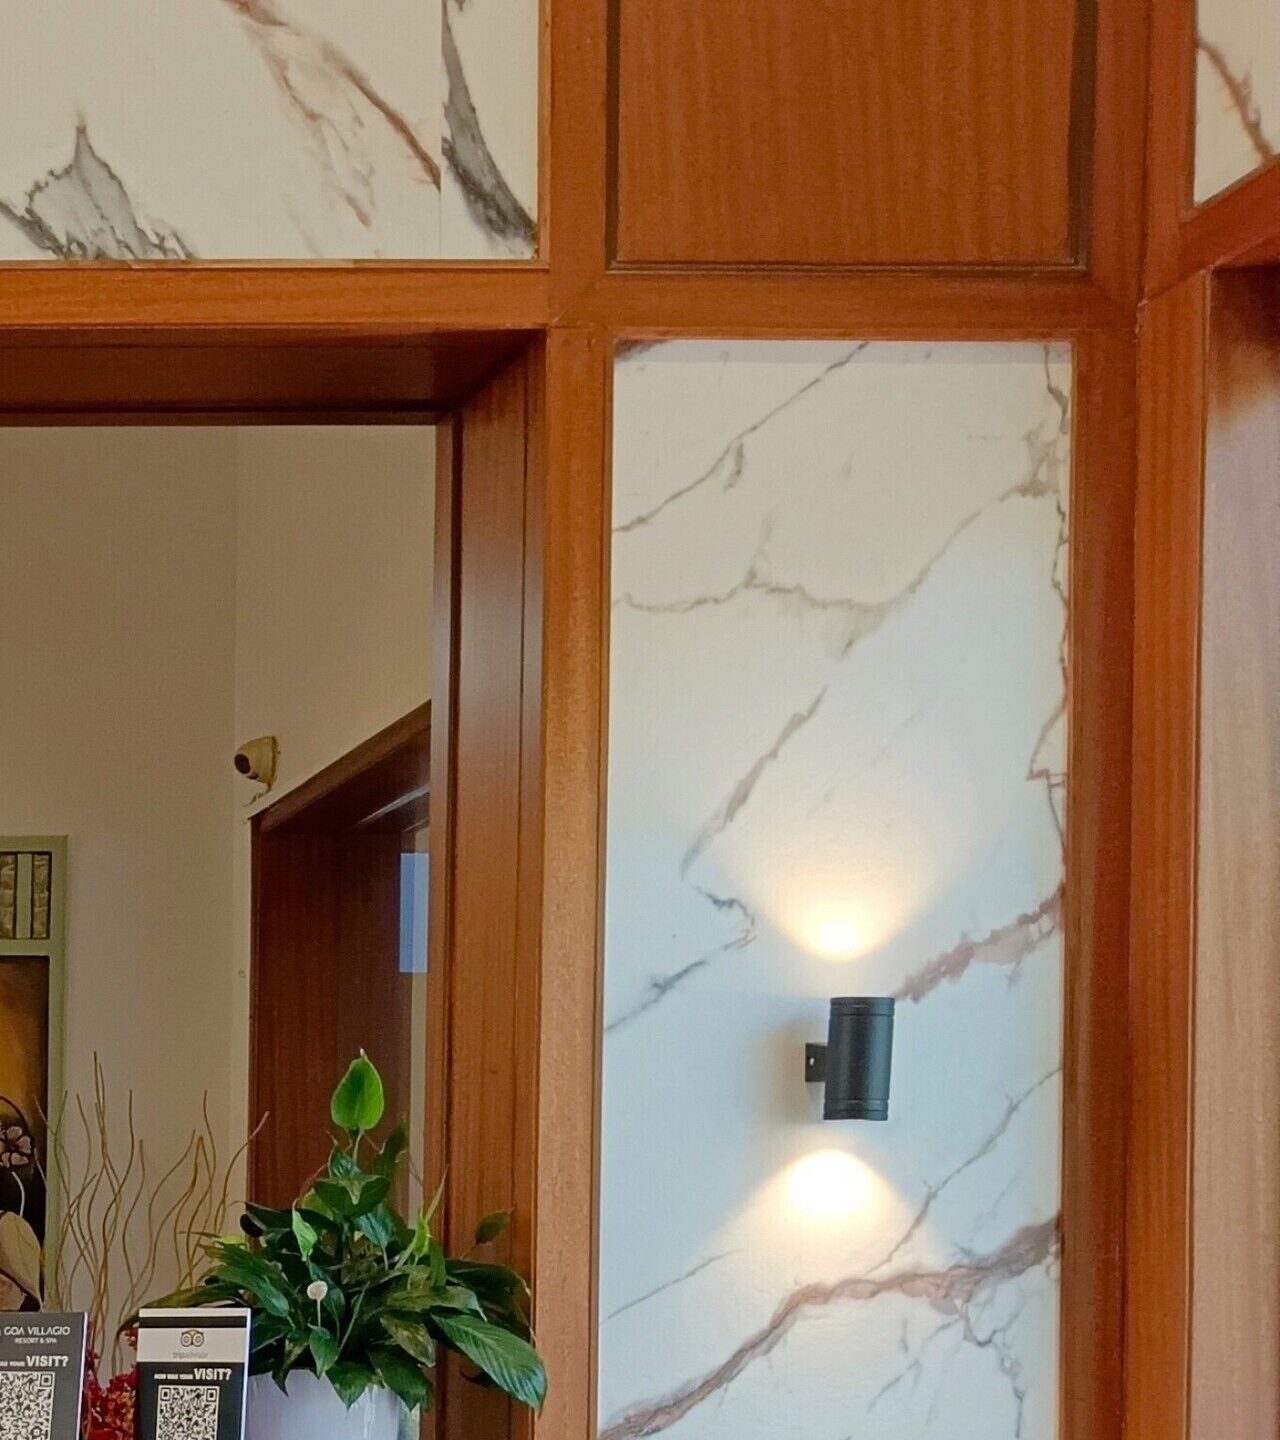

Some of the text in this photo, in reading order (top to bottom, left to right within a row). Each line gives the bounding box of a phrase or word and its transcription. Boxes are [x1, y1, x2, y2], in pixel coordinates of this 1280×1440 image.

[3, 1326, 71, 1336] GOA VILLAGIO
[26, 1355, 69, 1367] VISIT?
[193, 1368, 232, 1380] VISIT?
